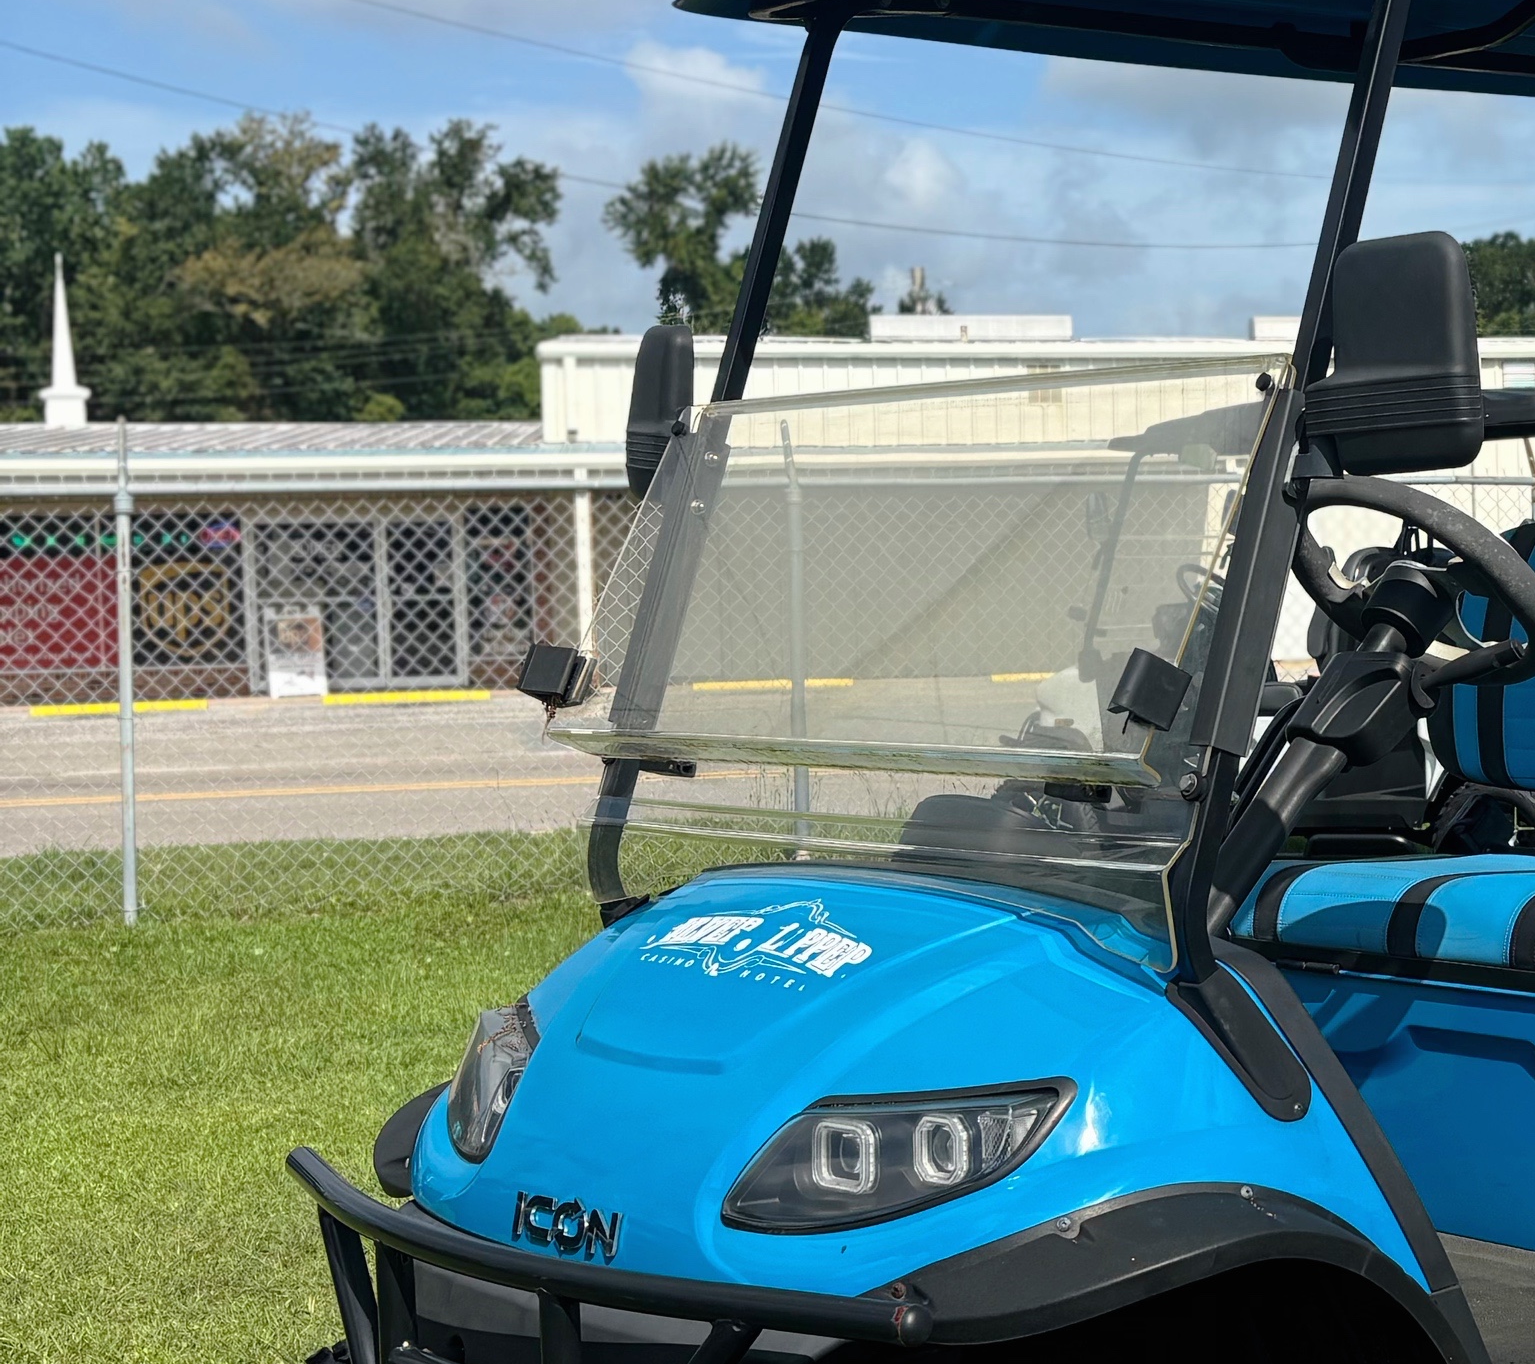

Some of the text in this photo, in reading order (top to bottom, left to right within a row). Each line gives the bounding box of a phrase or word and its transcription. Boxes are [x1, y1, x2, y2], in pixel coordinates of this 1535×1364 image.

[640, 953, 806, 992] CASINO HOTEL
[511, 1189, 624, 1261] ICON
